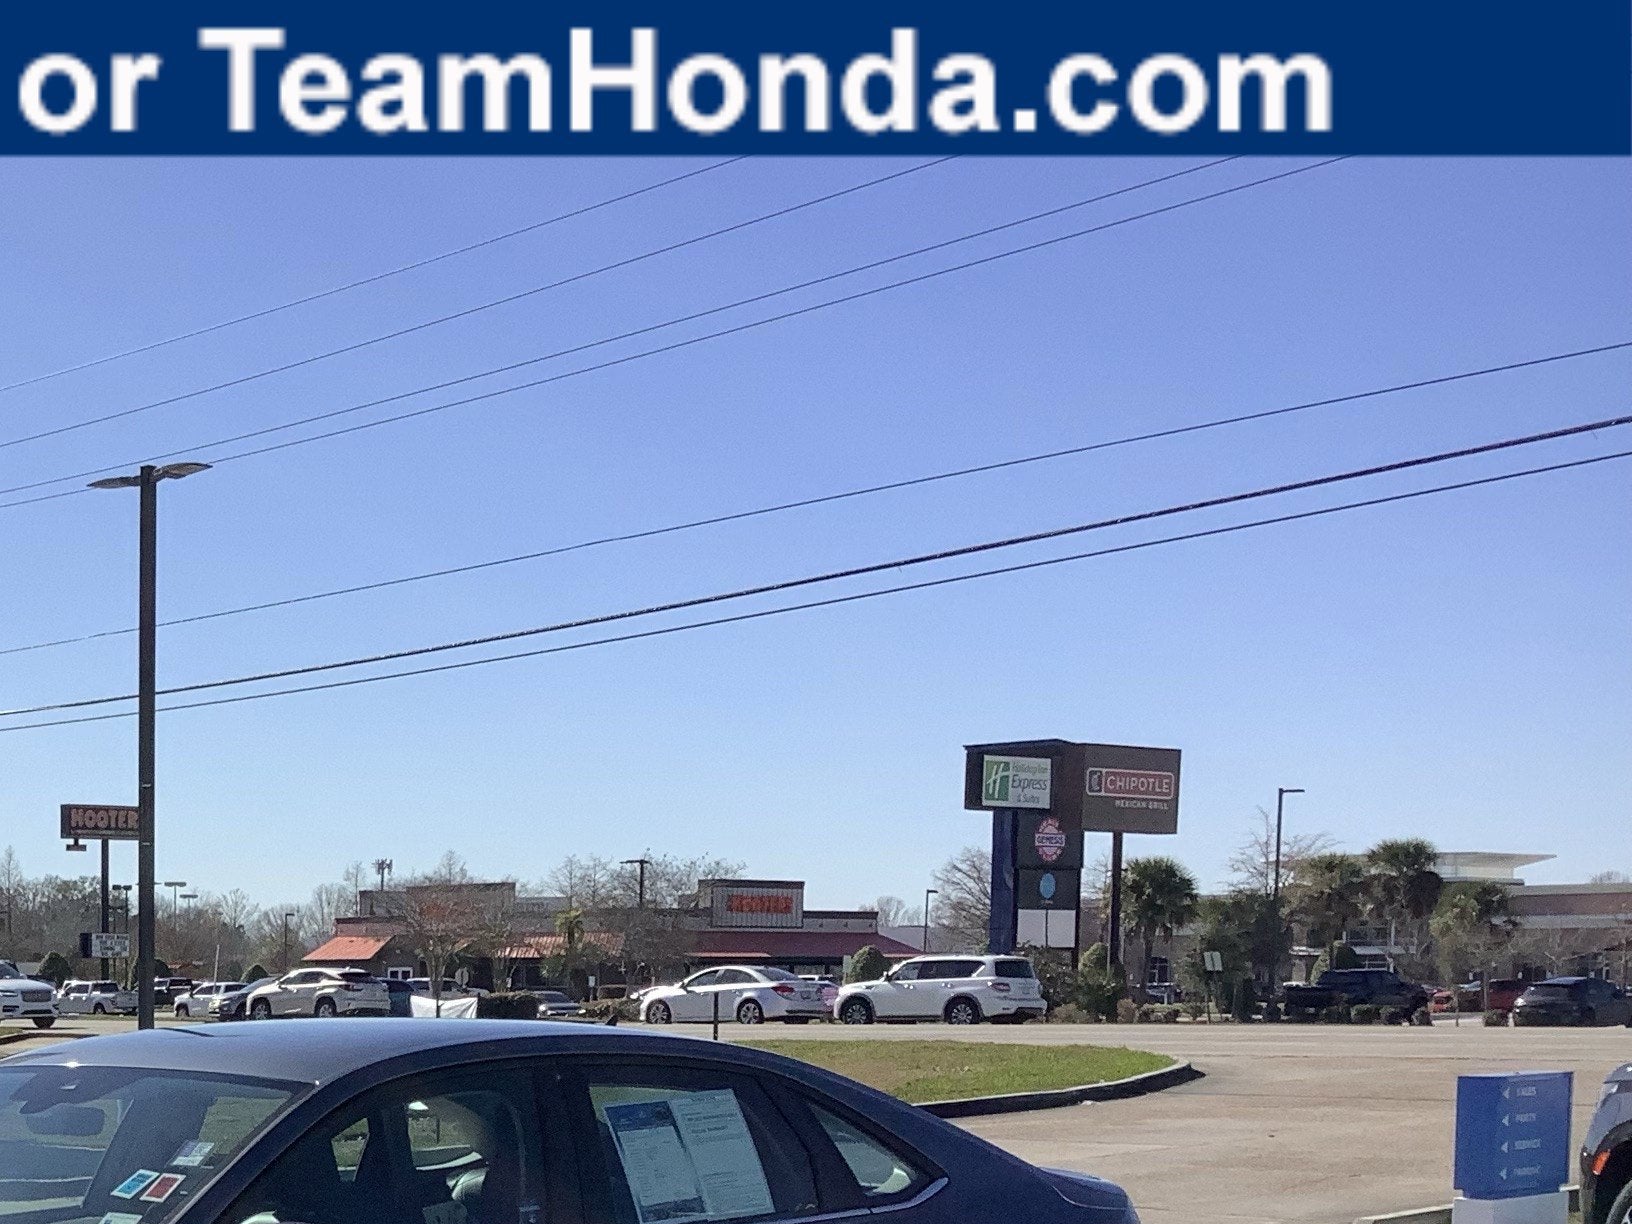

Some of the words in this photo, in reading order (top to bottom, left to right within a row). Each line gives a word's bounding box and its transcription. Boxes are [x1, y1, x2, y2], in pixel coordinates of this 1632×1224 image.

[1011, 774, 1048, 792] Express
[1107, 775, 1170, 792] CHIPOTLE
[71, 808, 140, 829] HOOTER
